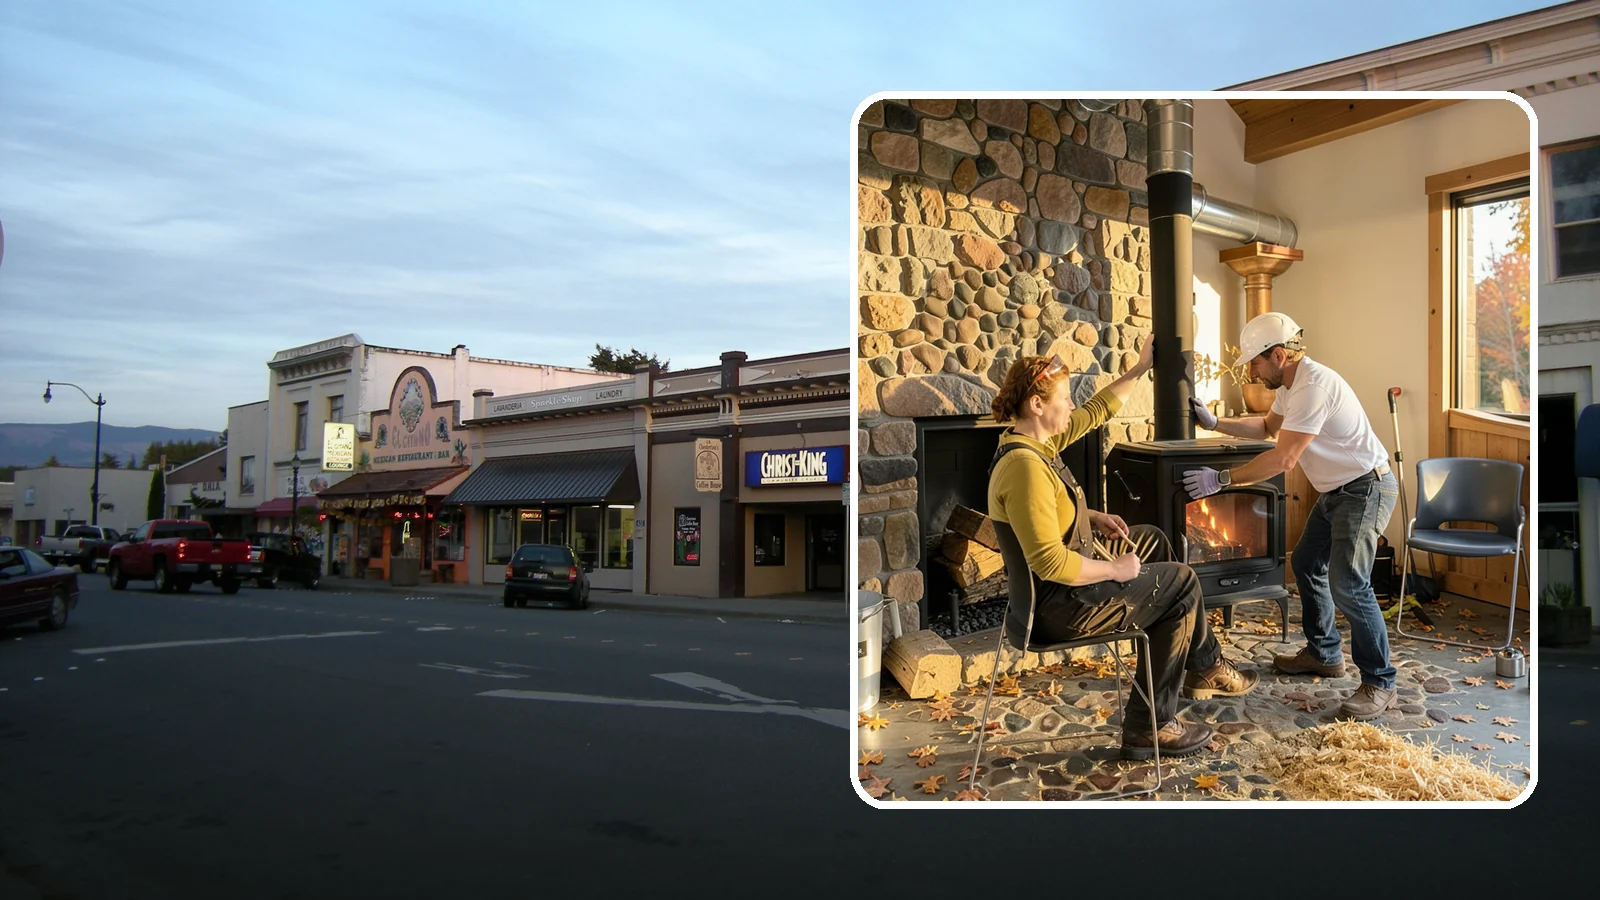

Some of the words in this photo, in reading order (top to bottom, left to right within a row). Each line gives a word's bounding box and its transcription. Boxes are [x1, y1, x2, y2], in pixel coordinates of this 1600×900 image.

[562, 394, 582, 406] Shop
[595, 389, 624, 400] LAUNDRY
[493, 402, 523, 413] LAVANDERIA
[373, 455, 396, 464] MEXICAN
[397, 451, 434, 463] RESTAURANT
[438, 450, 450, 459] BAR
